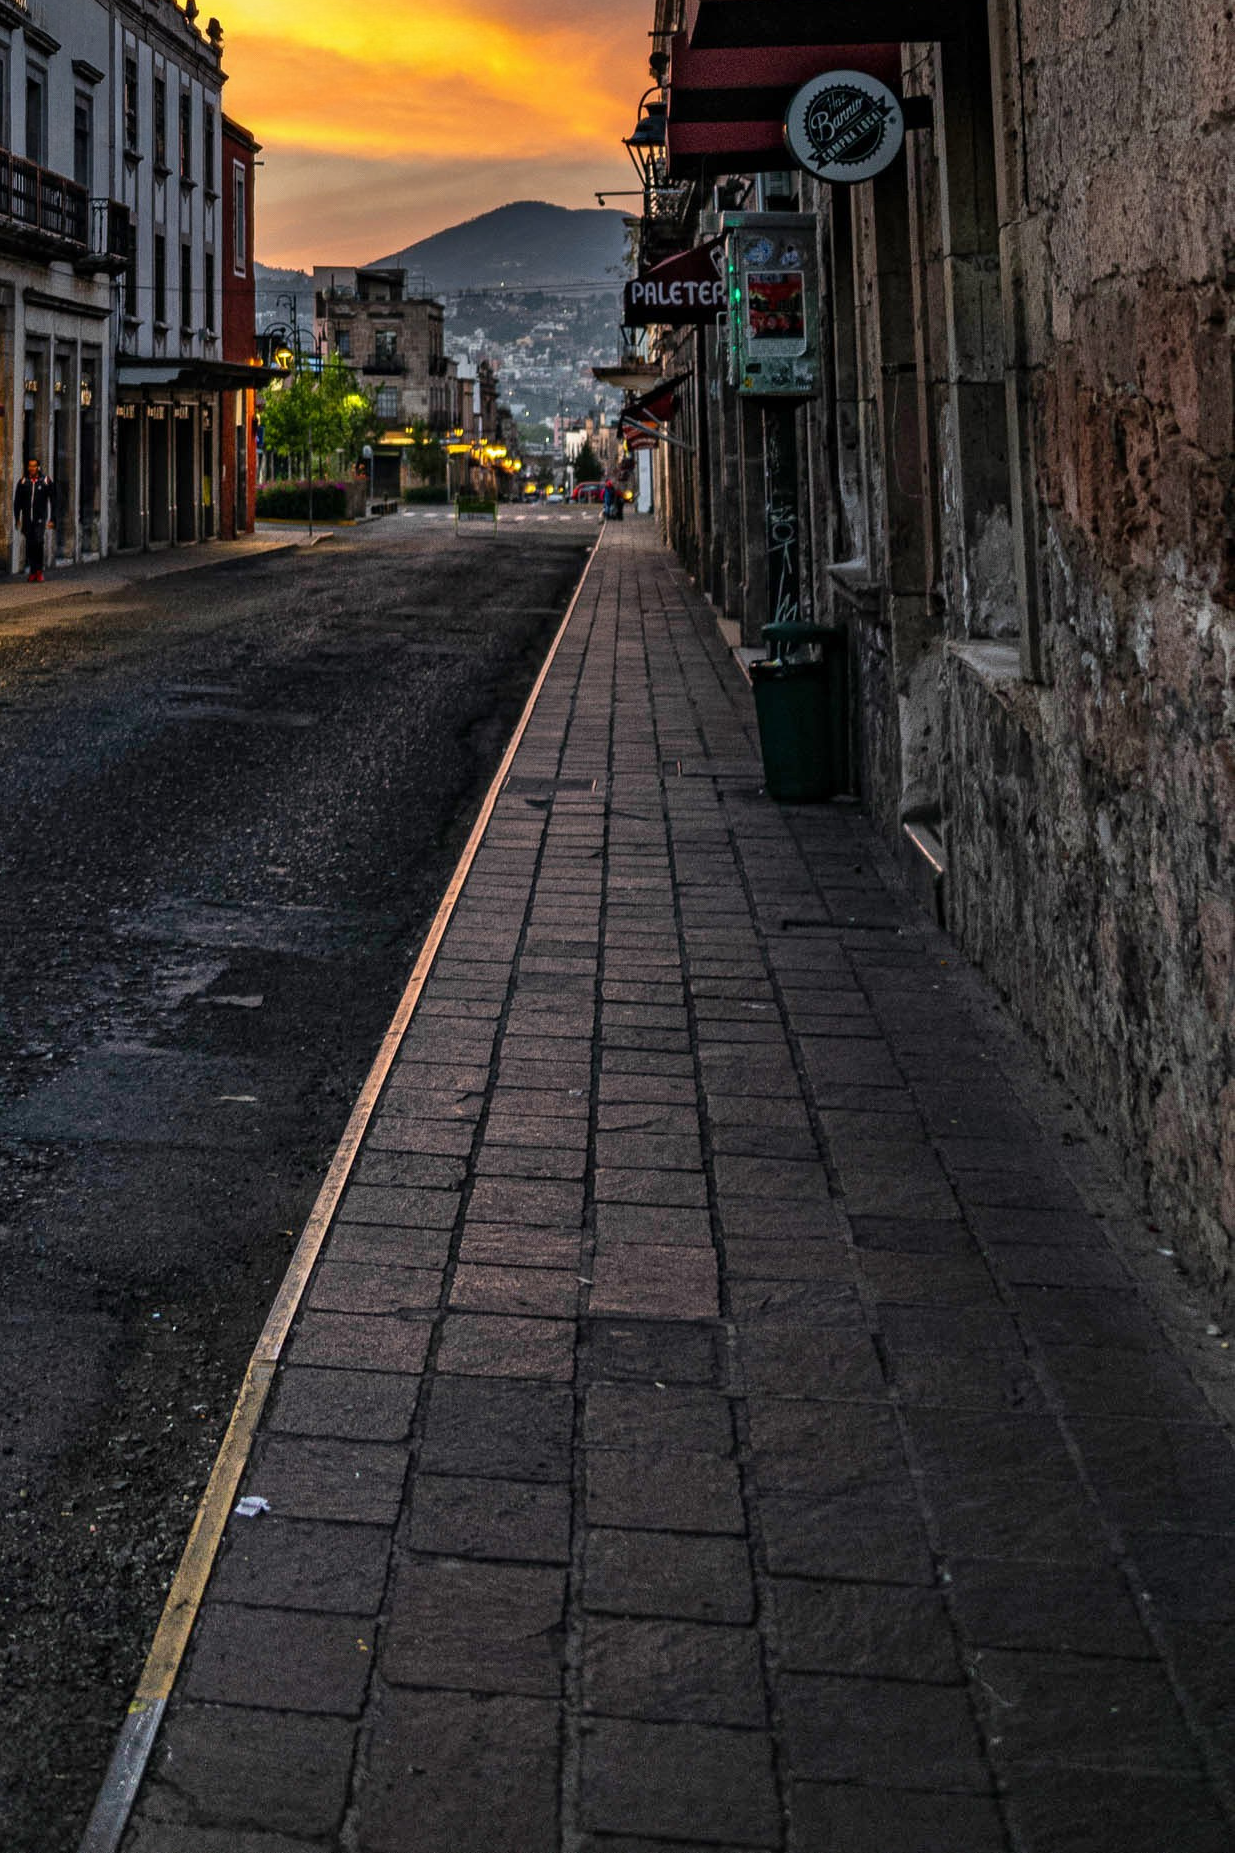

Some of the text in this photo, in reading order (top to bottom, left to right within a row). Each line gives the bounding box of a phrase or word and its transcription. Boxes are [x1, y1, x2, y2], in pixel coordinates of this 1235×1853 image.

[810, 97, 864, 141] Barrio
[821, 109, 884, 162] COMPRA LOCAL
[631, 280, 726, 305] PALETER
